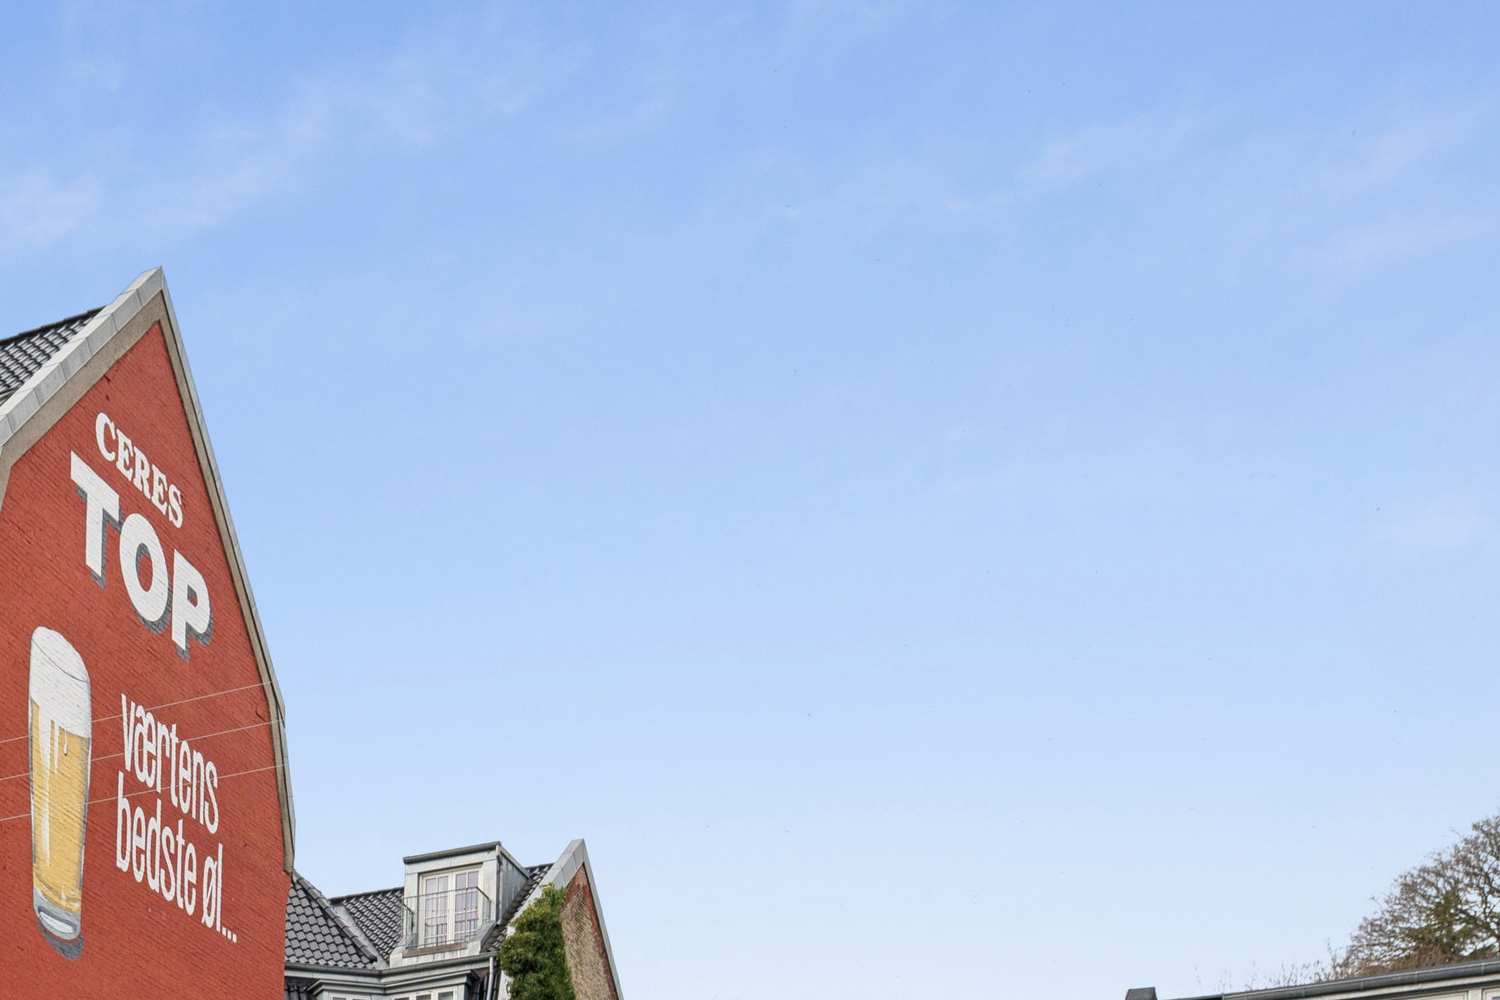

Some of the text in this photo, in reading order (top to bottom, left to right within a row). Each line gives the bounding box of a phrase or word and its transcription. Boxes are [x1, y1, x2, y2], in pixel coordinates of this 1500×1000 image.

[95, 412, 182, 528] CERES
[70, 450, 212, 655] TOP
[121, 693, 219, 834] værtens
[116, 771, 237, 943] bedste øl...
